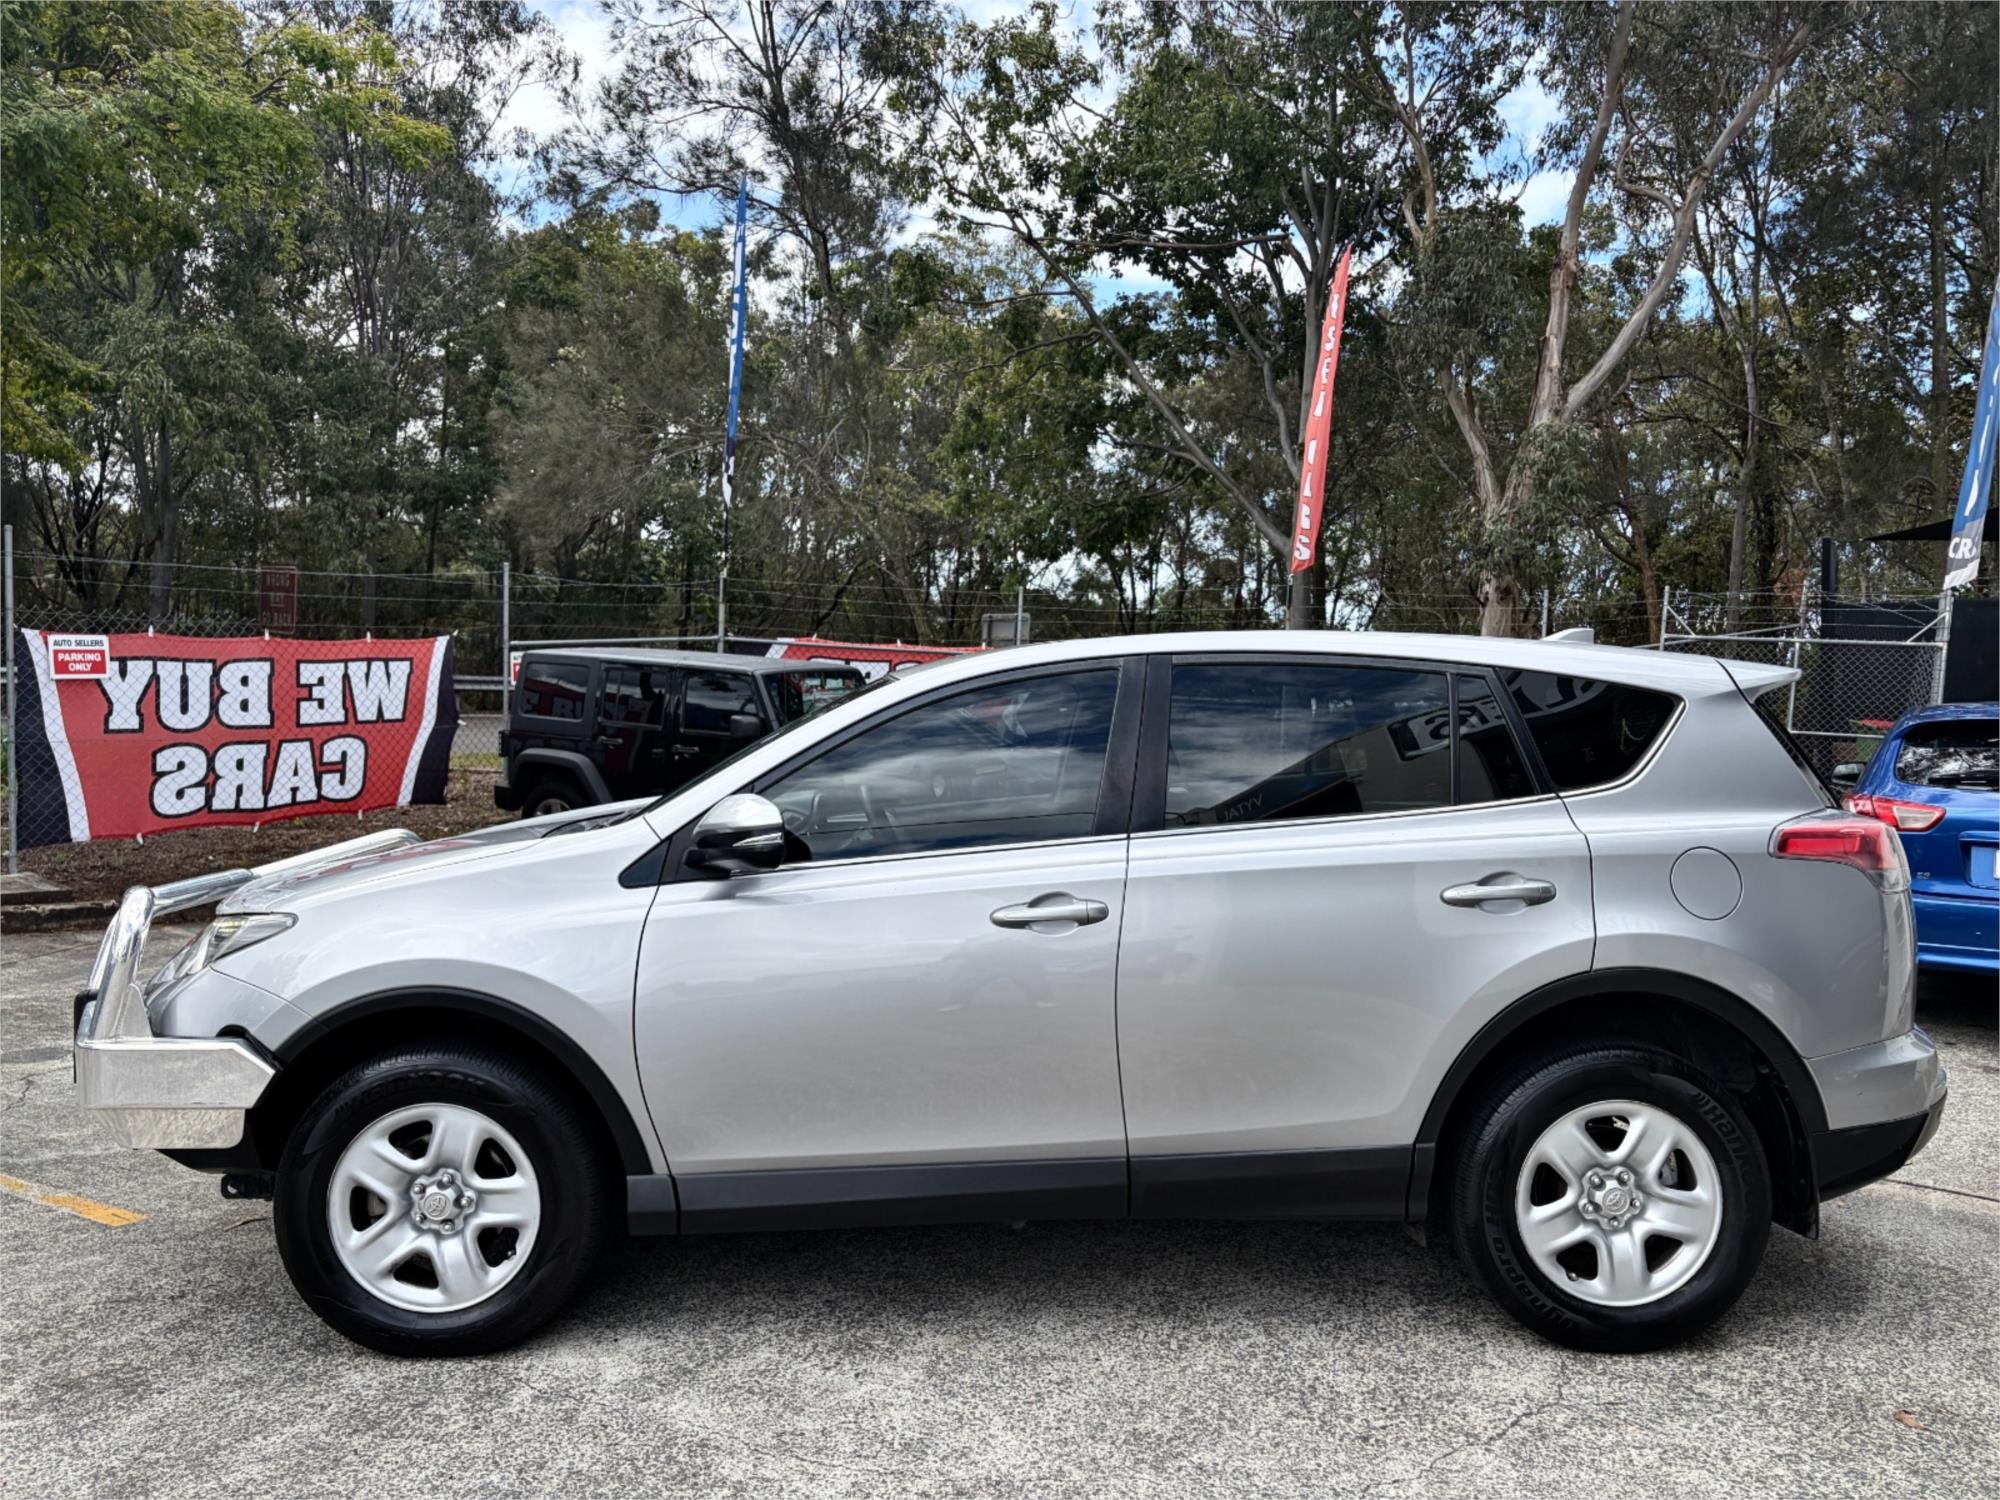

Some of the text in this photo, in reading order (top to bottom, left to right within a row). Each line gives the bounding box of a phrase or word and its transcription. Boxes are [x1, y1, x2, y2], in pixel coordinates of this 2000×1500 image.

[53, 639, 105, 647] AUTO SELLERS
[57, 652, 102, 662] PARKING
[68, 662, 93, 672] ONLY
